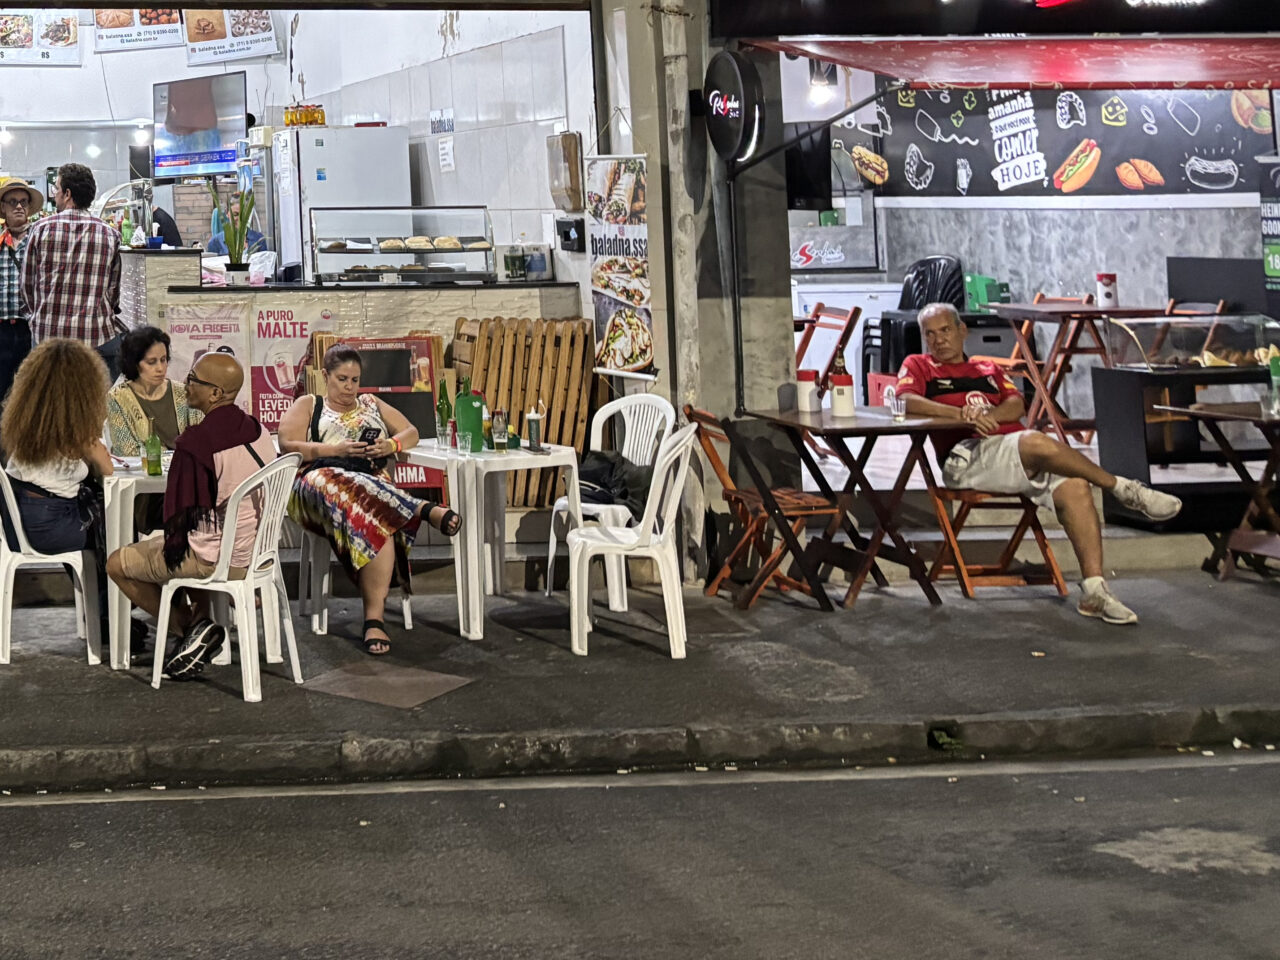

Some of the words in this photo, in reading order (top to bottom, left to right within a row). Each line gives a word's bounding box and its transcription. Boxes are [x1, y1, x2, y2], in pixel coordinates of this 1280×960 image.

[41, 51, 50, 59] R$
[1000, 159, 1041, 184] HOJE
[257, 310, 265, 321] A
[266, 310, 293, 321] PURO
[257, 321, 309, 339] MALTE
